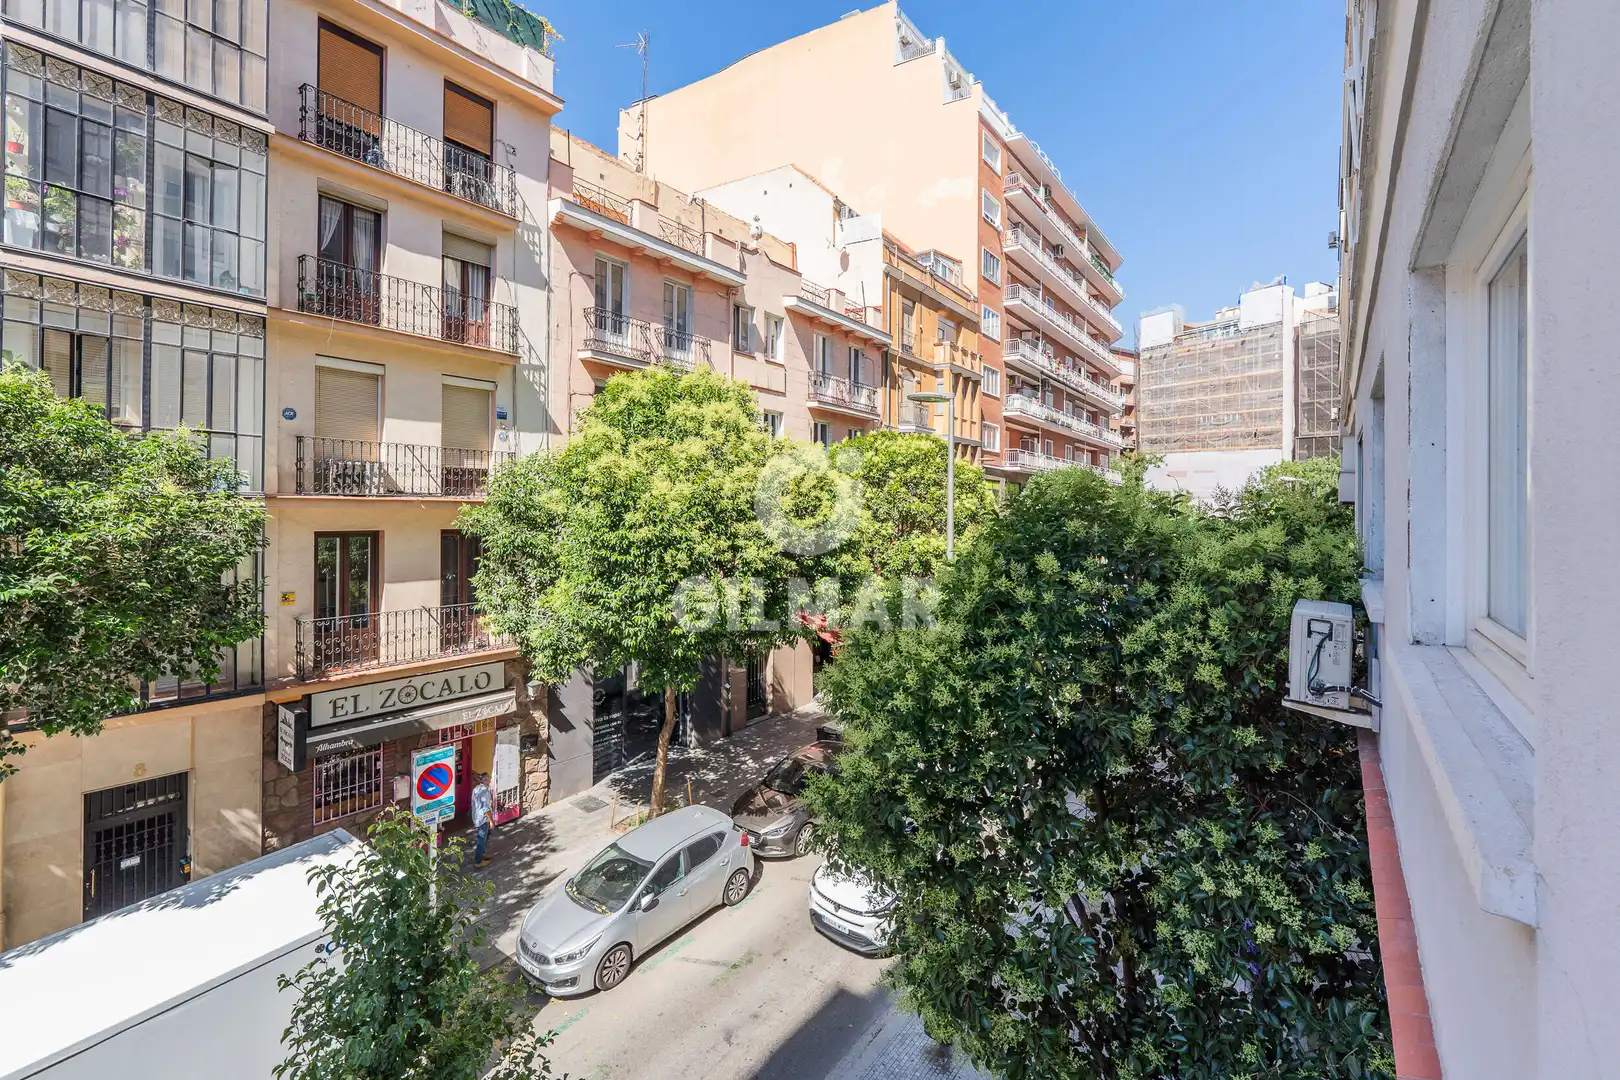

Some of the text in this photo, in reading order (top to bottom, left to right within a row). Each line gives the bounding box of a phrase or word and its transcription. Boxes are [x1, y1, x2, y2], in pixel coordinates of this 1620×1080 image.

[329, 671, 491, 719] EL ZÓCALO
[462, 711, 474, 720] EL
[315, 739, 354, 753] Alhambra
